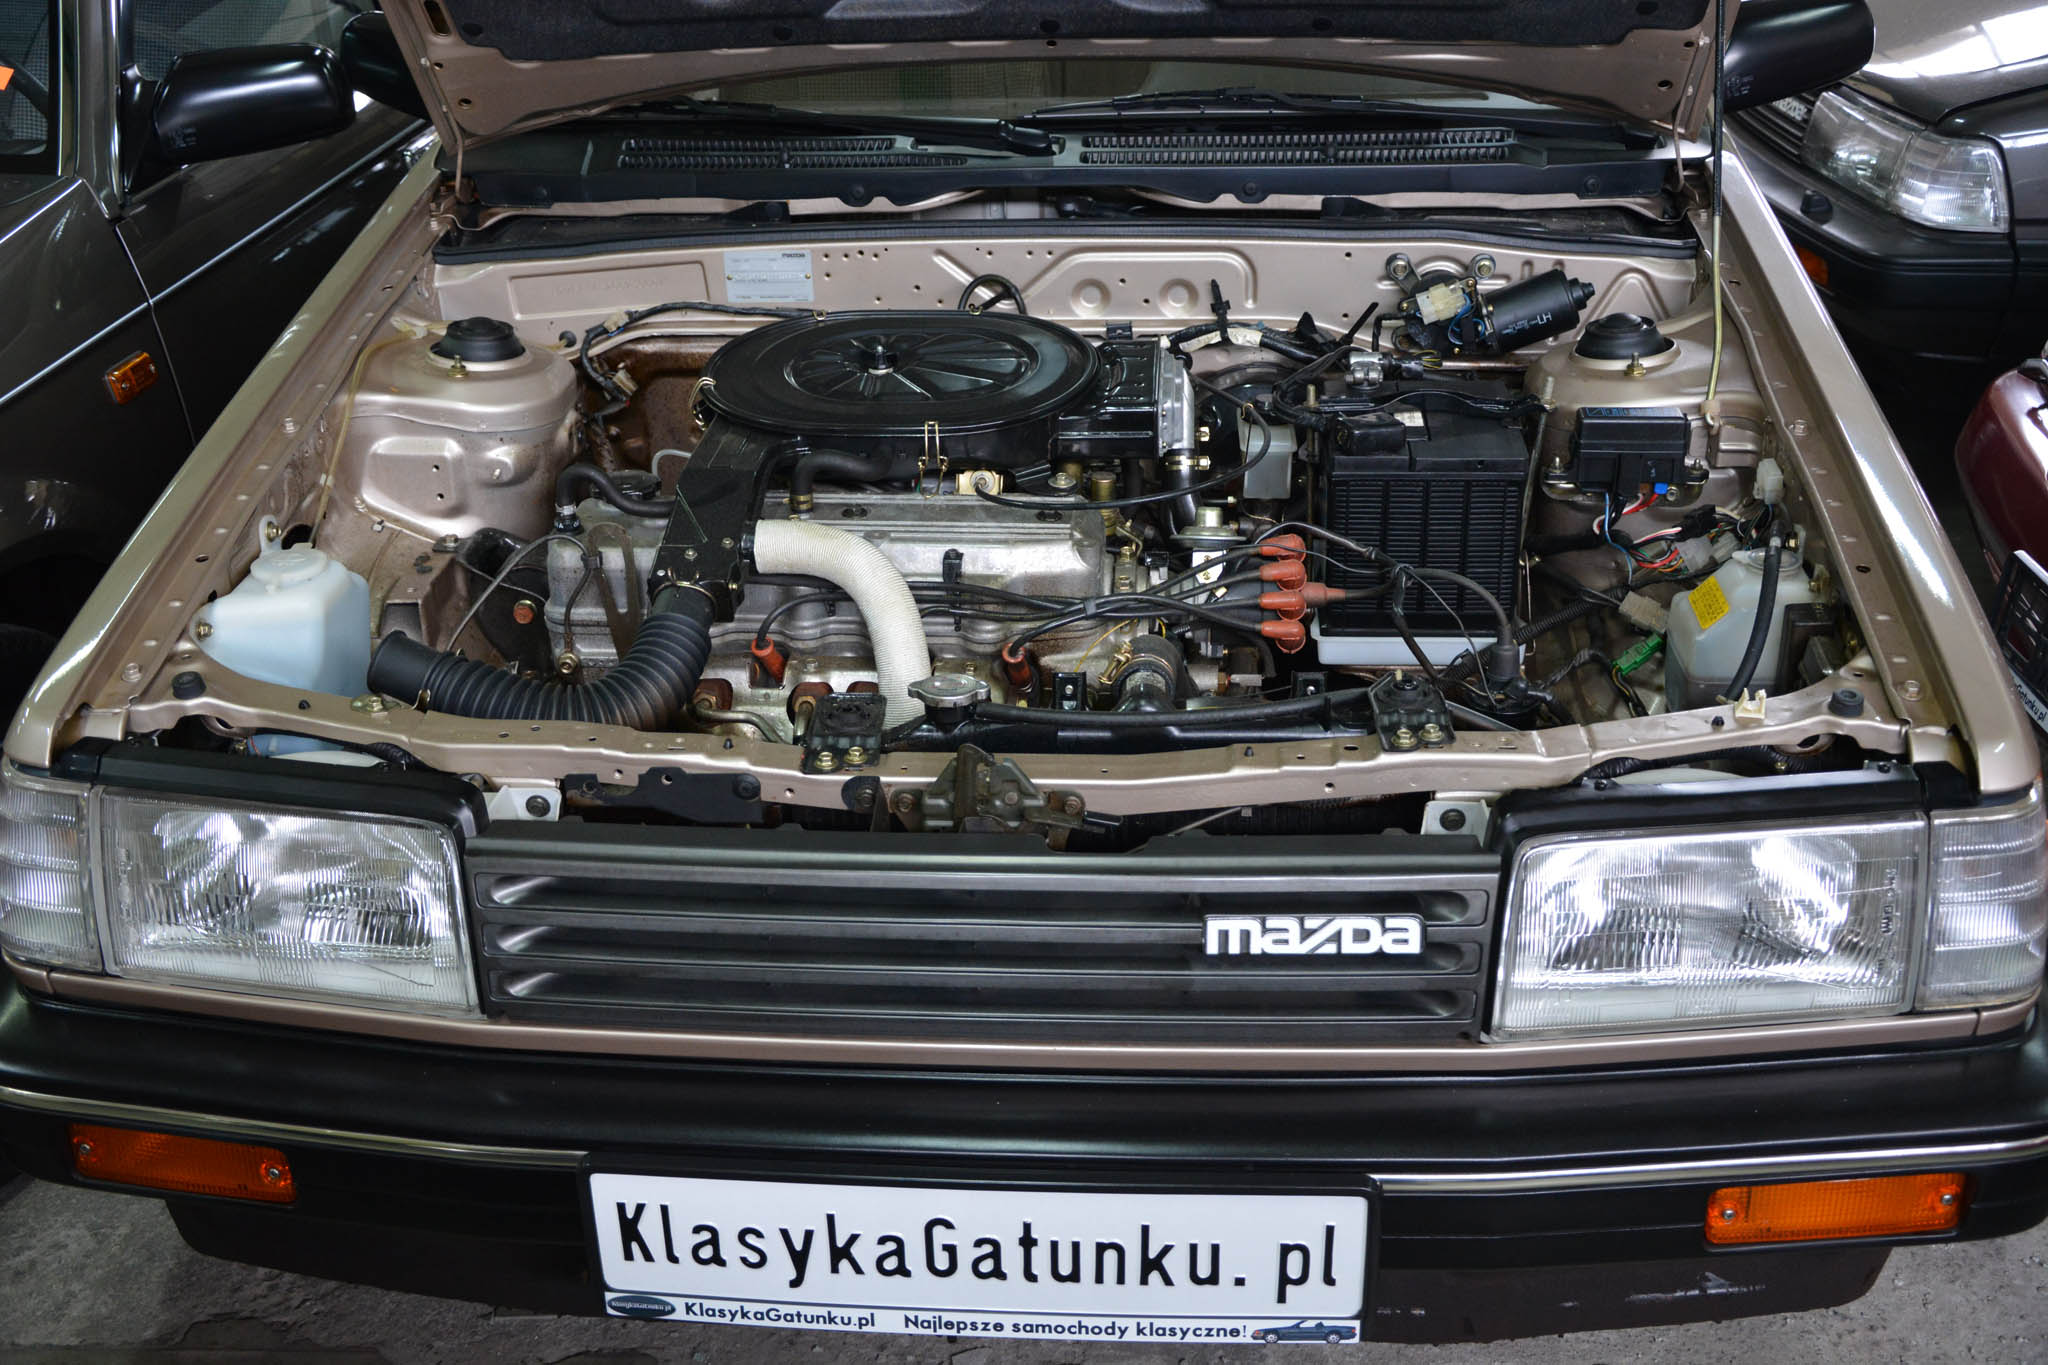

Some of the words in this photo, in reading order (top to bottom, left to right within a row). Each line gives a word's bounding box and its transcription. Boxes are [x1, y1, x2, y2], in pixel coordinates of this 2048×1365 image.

[684, 1302, 876, 1329] KlasykaGatunku.pl
[904, 1314, 1005, 1333] Najlepsze
[1012, 1320, 1129, 1338] samochody
[1136, 1321, 1247, 1340] klasyczne!
